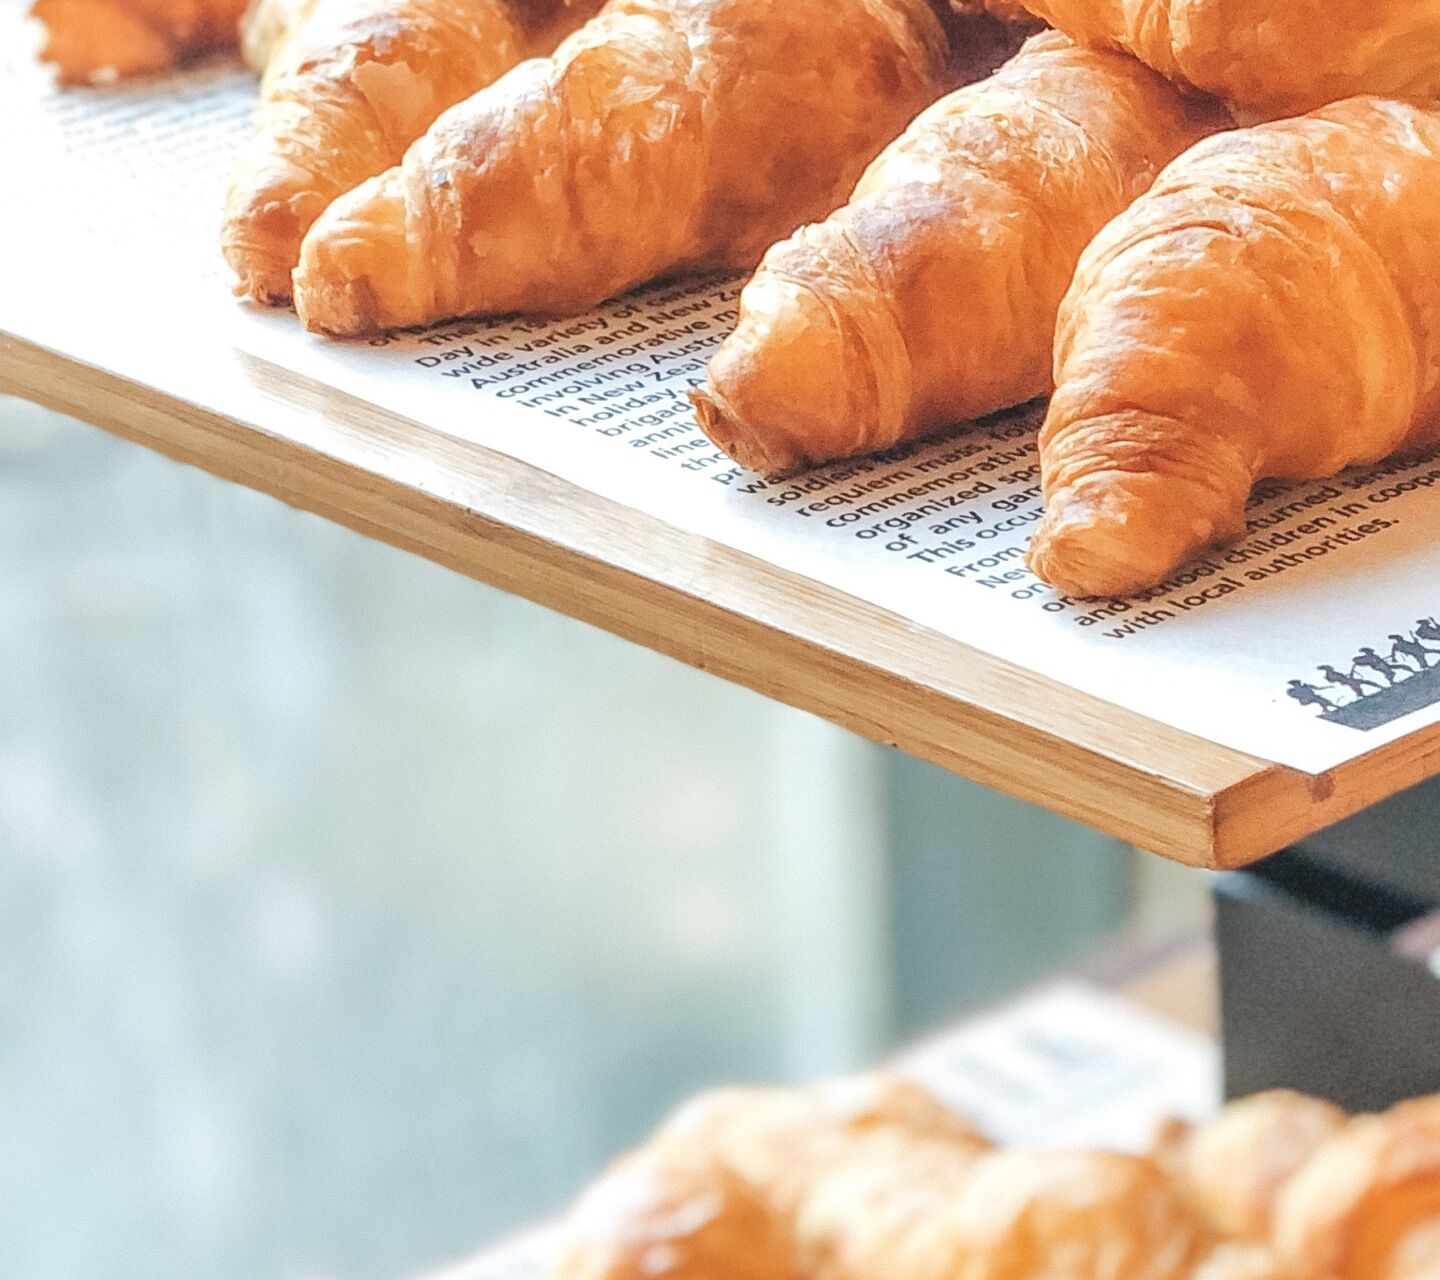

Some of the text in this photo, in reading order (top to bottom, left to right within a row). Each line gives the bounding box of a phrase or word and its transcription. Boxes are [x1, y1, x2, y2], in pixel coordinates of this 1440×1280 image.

[415, 336, 509, 367] Day in
[442, 353, 513, 377] wide
[515, 318, 608, 351] variety
[612, 304, 642, 318] of
[472, 345, 592, 389] Australia
[595, 322, 649, 344] and
[647, 300, 711, 324] New
[496, 322, 710, 403] commemorative
[517, 364, 650, 412] involving
[578, 381, 644, 404] New
[767, 466, 874, 506] soldiers
[796, 472, 914, 517] requiem
[914, 444, 992, 472] mass,
[856, 482, 996, 538] organized
[886, 512, 983, 551] of any
[907, 539, 975, 562] This
[945, 548, 1026, 577] From
[1074, 599, 1132, 626] and
[1225, 517, 1336, 563] children
[1329, 503, 1368, 517] in
[1103, 519, 1399, 638] with local authorities.
